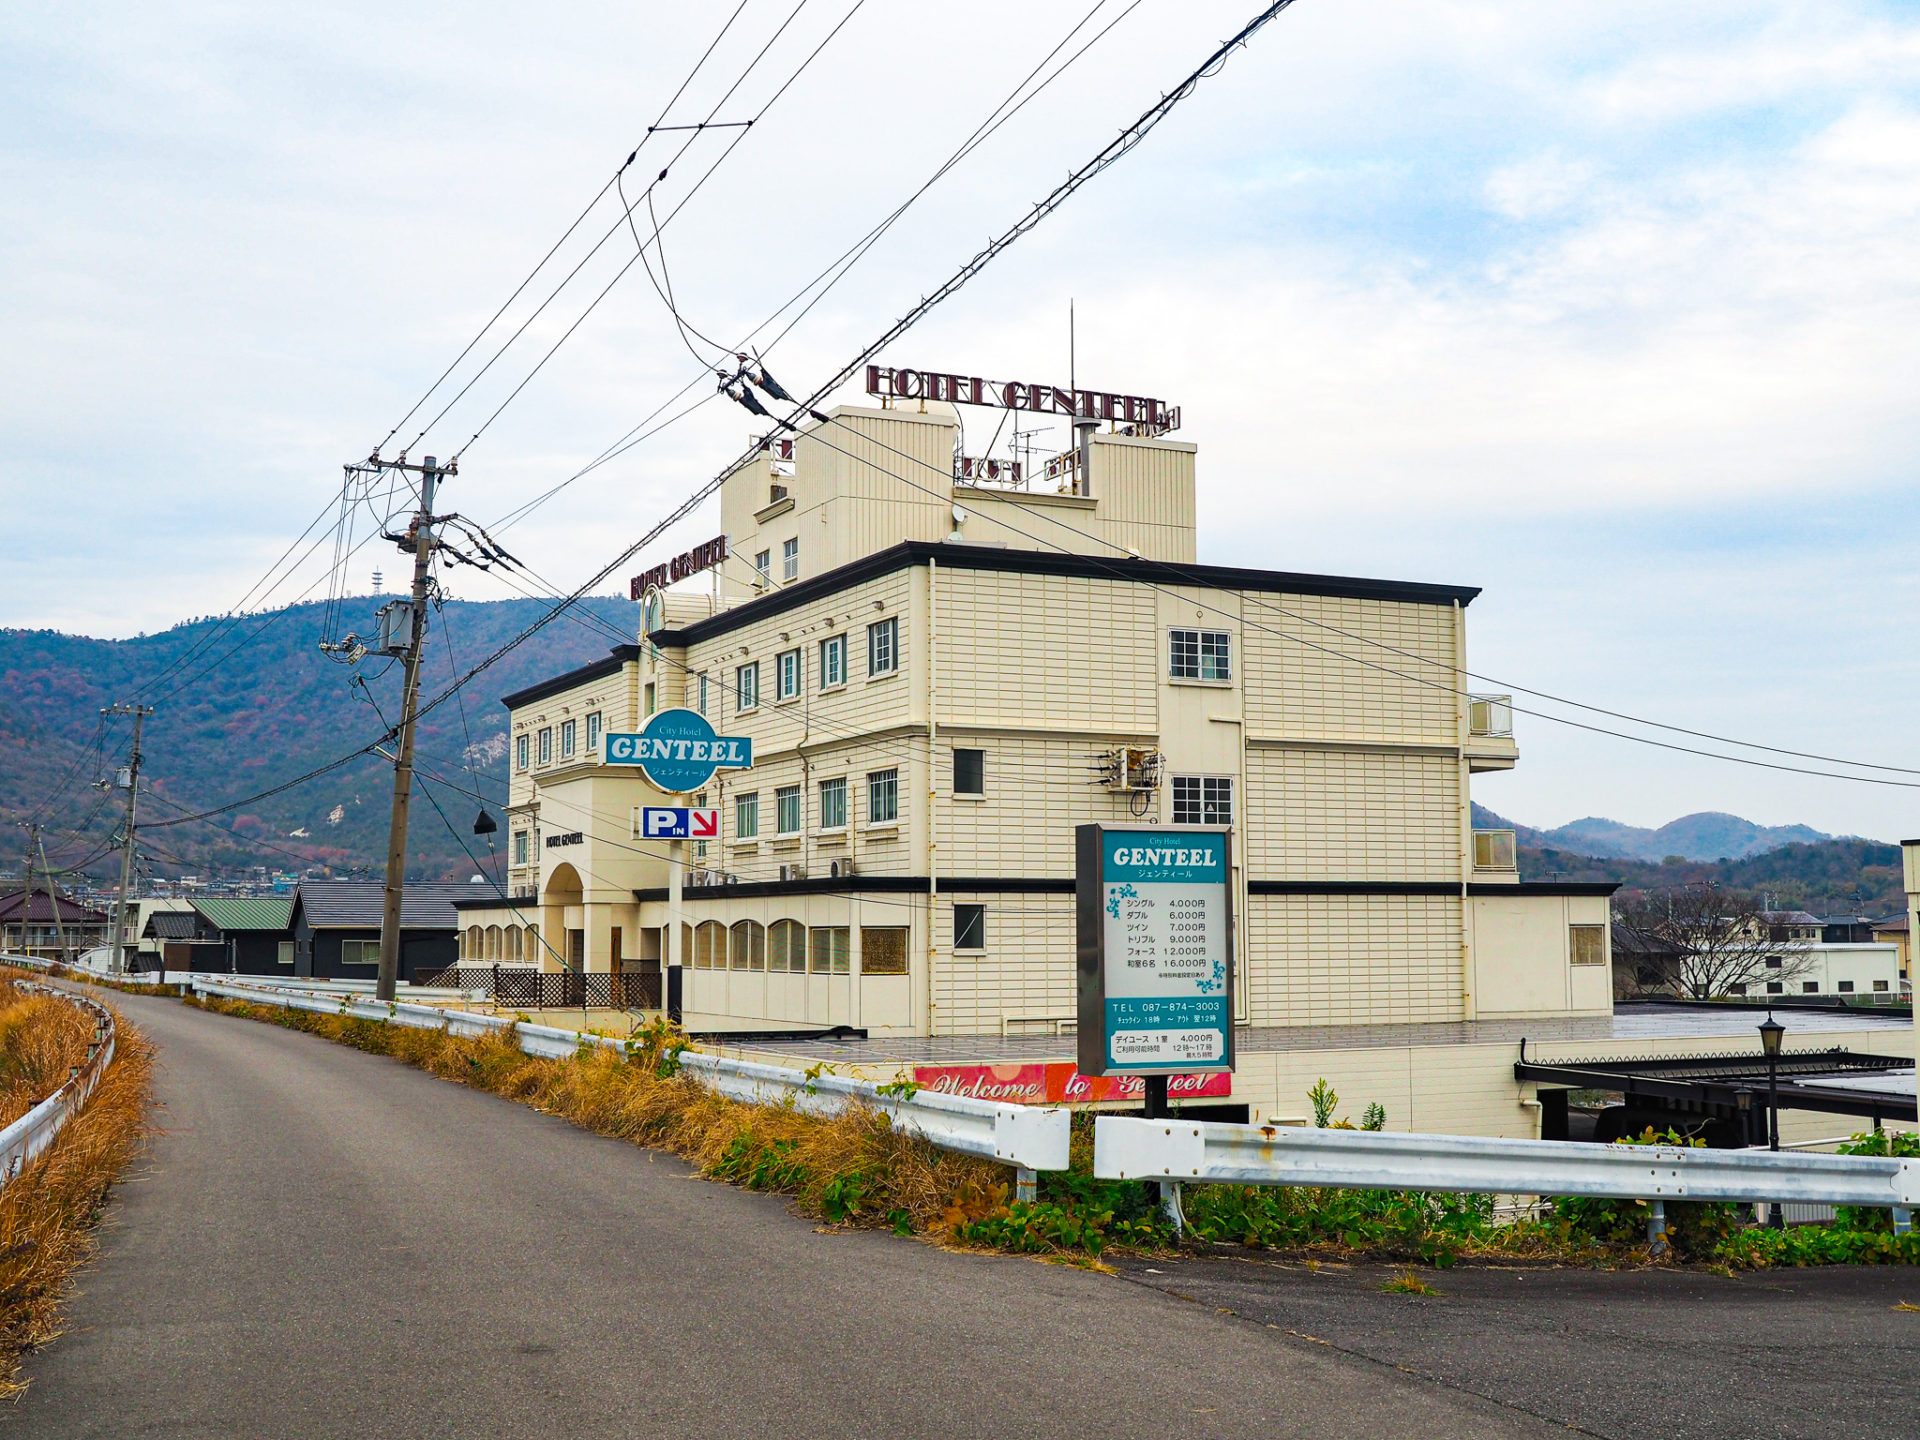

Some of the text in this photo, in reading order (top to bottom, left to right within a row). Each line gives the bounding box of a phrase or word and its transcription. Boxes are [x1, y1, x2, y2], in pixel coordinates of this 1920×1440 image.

[865, 364, 994, 407] HOTEL
[1002, 381, 1169, 426] GENTEEL
[670, 534, 731, 583] GENTEEL
[659, 726, 702, 737] City Hotel
[611, 737, 744, 763] GENTEEL
[651, 767, 707, 778] ジェンティール
[648, 810, 685, 835] P IN
[1149, 837, 1181, 846] City Hotel
[1113, 847, 1217, 867] GENTEEL
[1138, 869, 1193, 879] ジェンティール
[1127, 899, 1156, 908] シングル
[1126, 911, 1149, 920] ダブル
[1127, 923, 1149, 932] ツイン
[1128, 935, 1156, 944] トリプル
[1127, 947, 1156, 956] フォース
[1127, 959, 1156, 968] 和室6名
[1112, 1002, 1220, 1013] TEL 087-874-3003
[1144, 1015, 1160, 1024] 18時
[1115, 1035, 1150, 1044] デイユース
[932, 1074, 1042, 1099] Welcome
[1064, 1072, 1091, 1095] to
